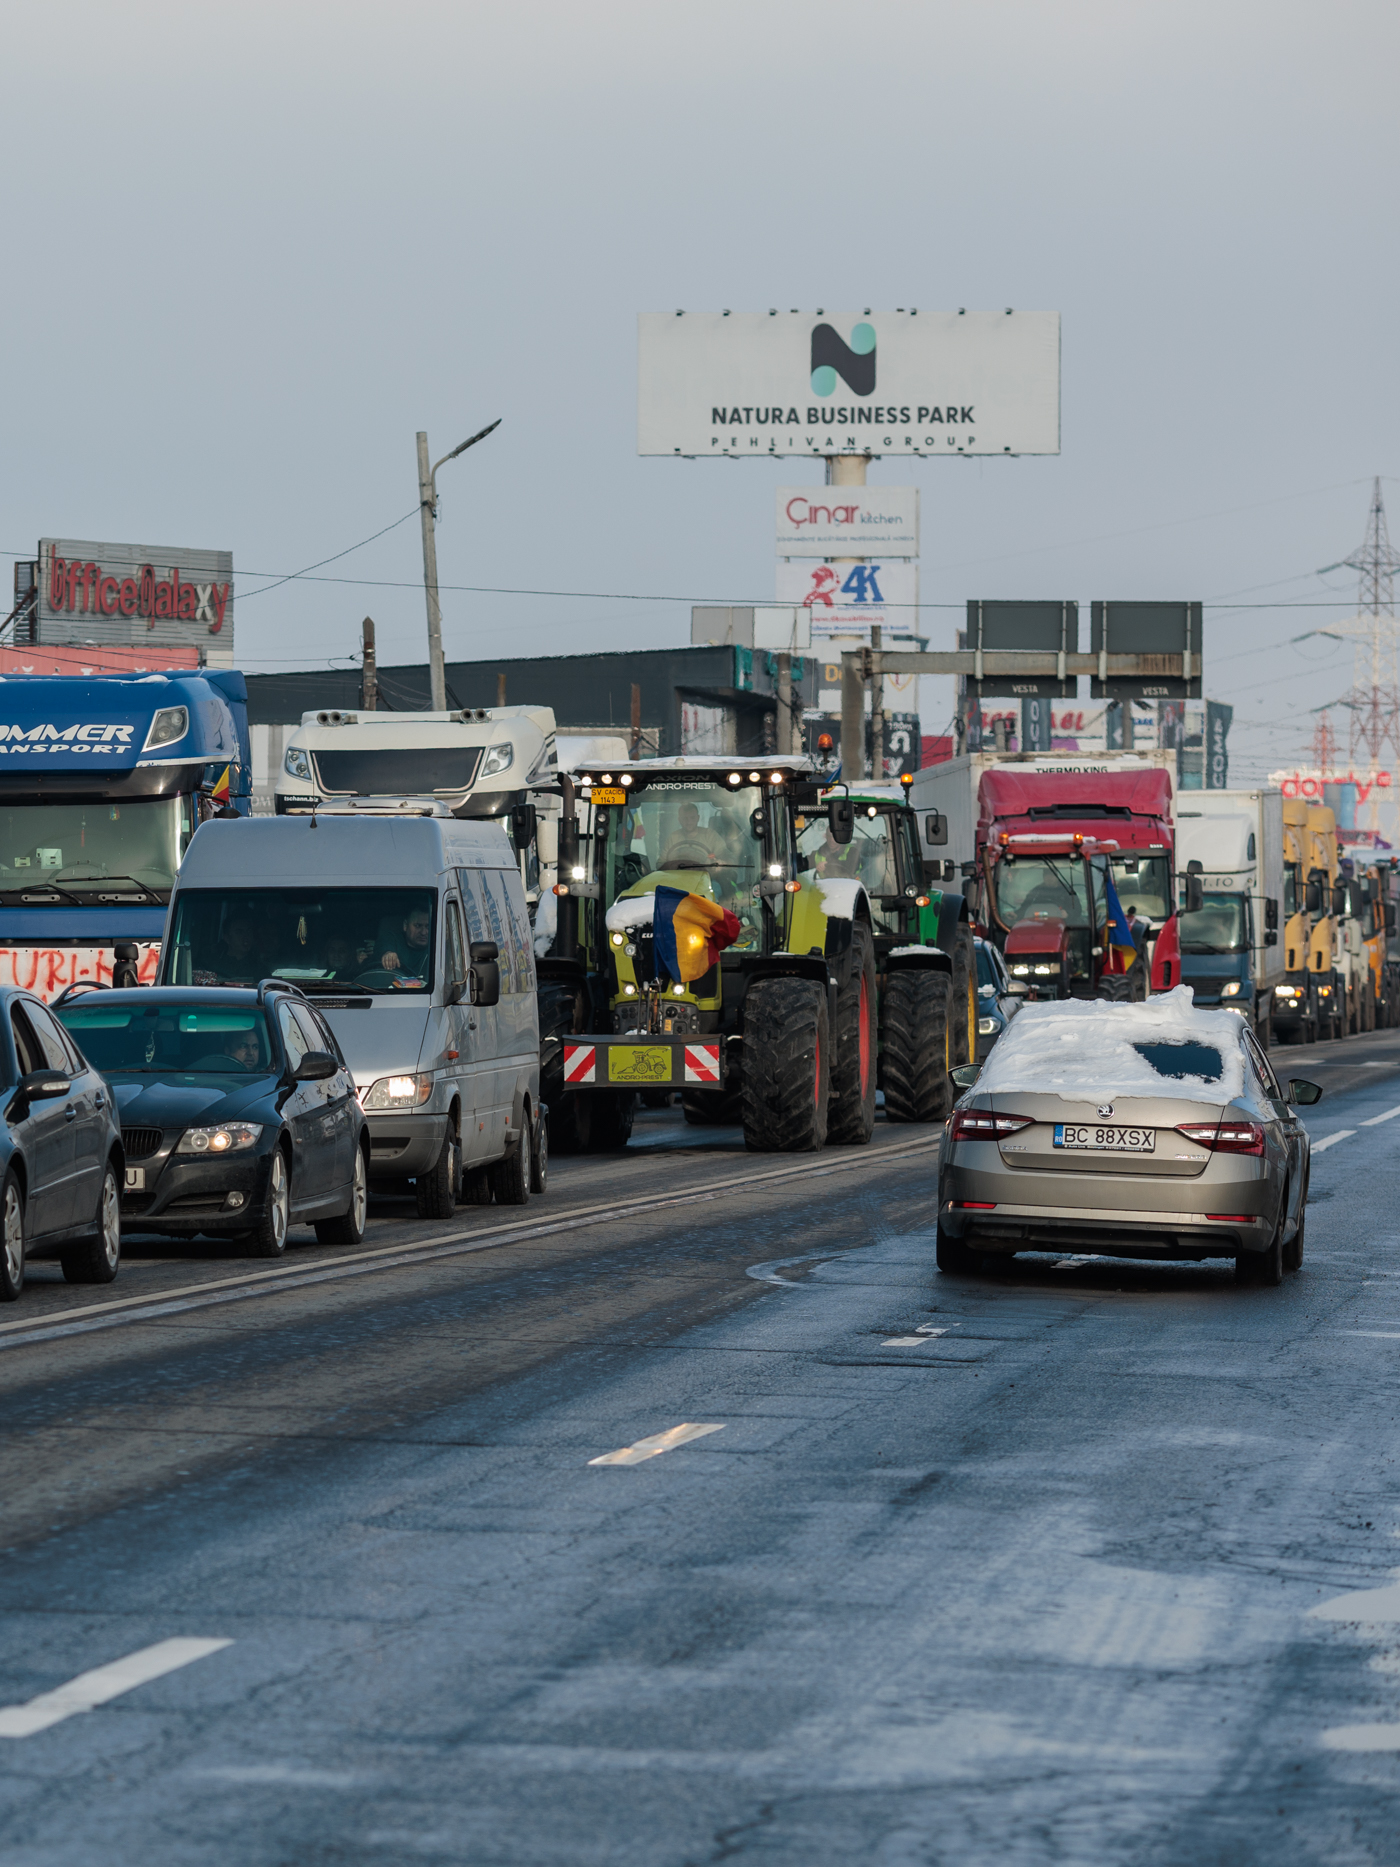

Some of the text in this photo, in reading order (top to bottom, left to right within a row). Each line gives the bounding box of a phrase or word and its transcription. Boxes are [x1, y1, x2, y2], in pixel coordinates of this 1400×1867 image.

[711, 405, 976, 425] NATURA BUSINESS PARK
[711, 436, 976, 447] PEHLIVAN GROUP
[860, 512, 904, 525] kitchen
[1011, 684, 1039, 694] VESTA
[1142, 686, 1169, 696] VESTA
[645, 782, 718, 791] ANDRO-PREST
[591, 788, 602, 796] SV
[1064, 1127, 1089, 1144] BC
